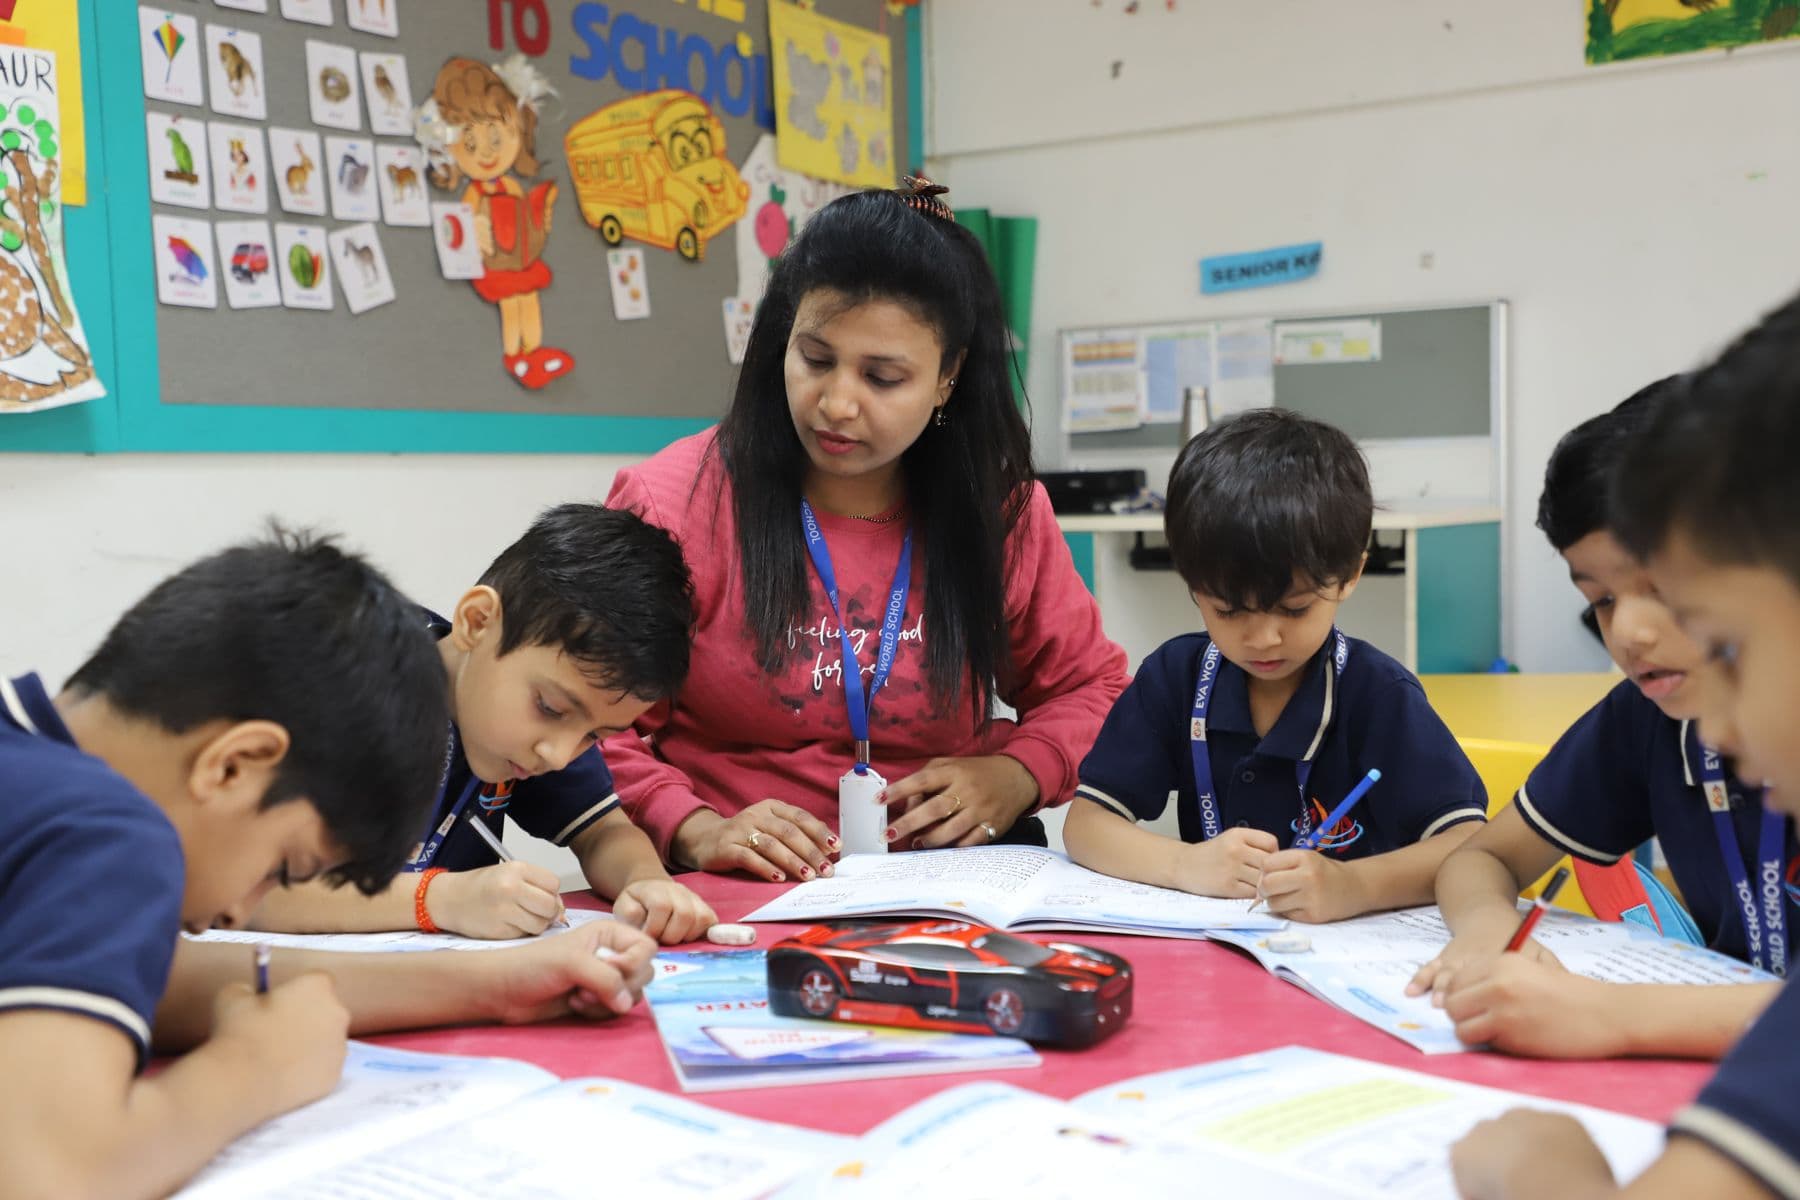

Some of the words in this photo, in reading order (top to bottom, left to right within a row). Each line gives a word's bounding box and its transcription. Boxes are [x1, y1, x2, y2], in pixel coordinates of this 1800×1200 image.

[569, 1, 776, 129] SCHOOL
[1211, 257, 1290, 285] SENIOR
[886, 588, 904, 631] SCHOOL
[879, 632, 894, 672] WORLD
[1200, 643, 1220, 682] WORL
[1195, 685, 1209, 709] EVA
[1200, 792, 1218, 841] CHOOL
[418, 841, 438, 863] EVA
[1736, 879, 1761, 952] SCHOOL
[1762, 859, 1783, 931] SCHOOL
[1768, 933, 1786, 976] ORLD
